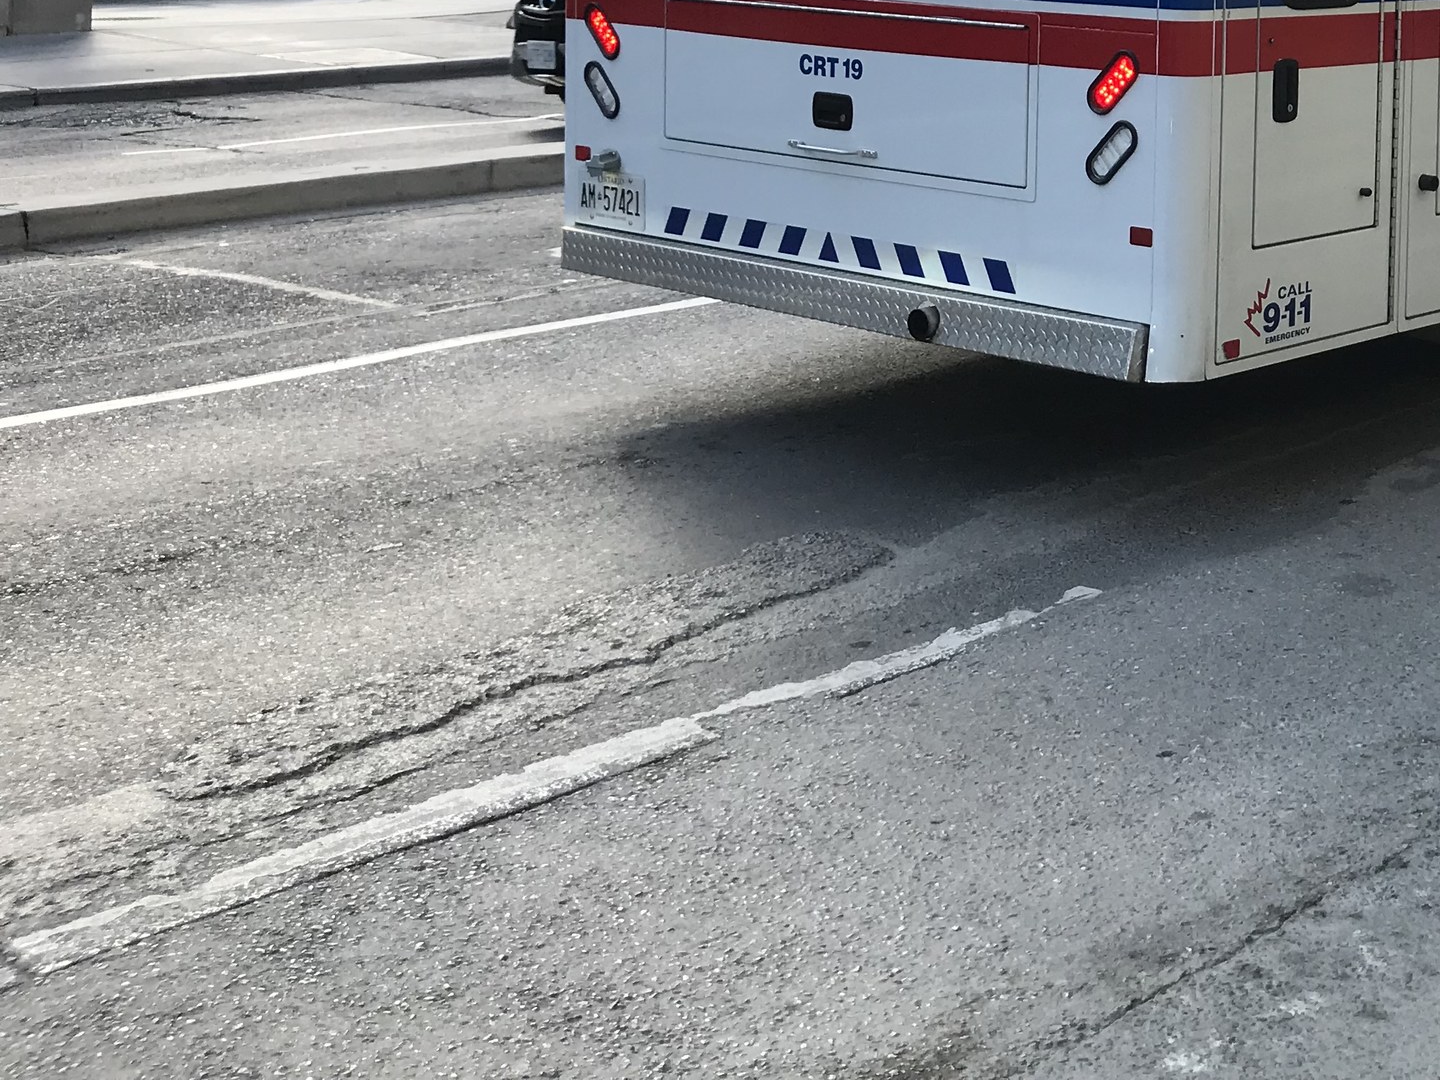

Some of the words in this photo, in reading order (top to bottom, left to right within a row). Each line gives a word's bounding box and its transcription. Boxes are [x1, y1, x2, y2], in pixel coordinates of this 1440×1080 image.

[799, 53, 839, 78] CRT
[842, 58, 863, 80] 19
[1278, 280, 1312, 299] CALL
[1263, 293, 1311, 333] 9-1-1
[1265, 326, 1311, 344] EMERGENCY
